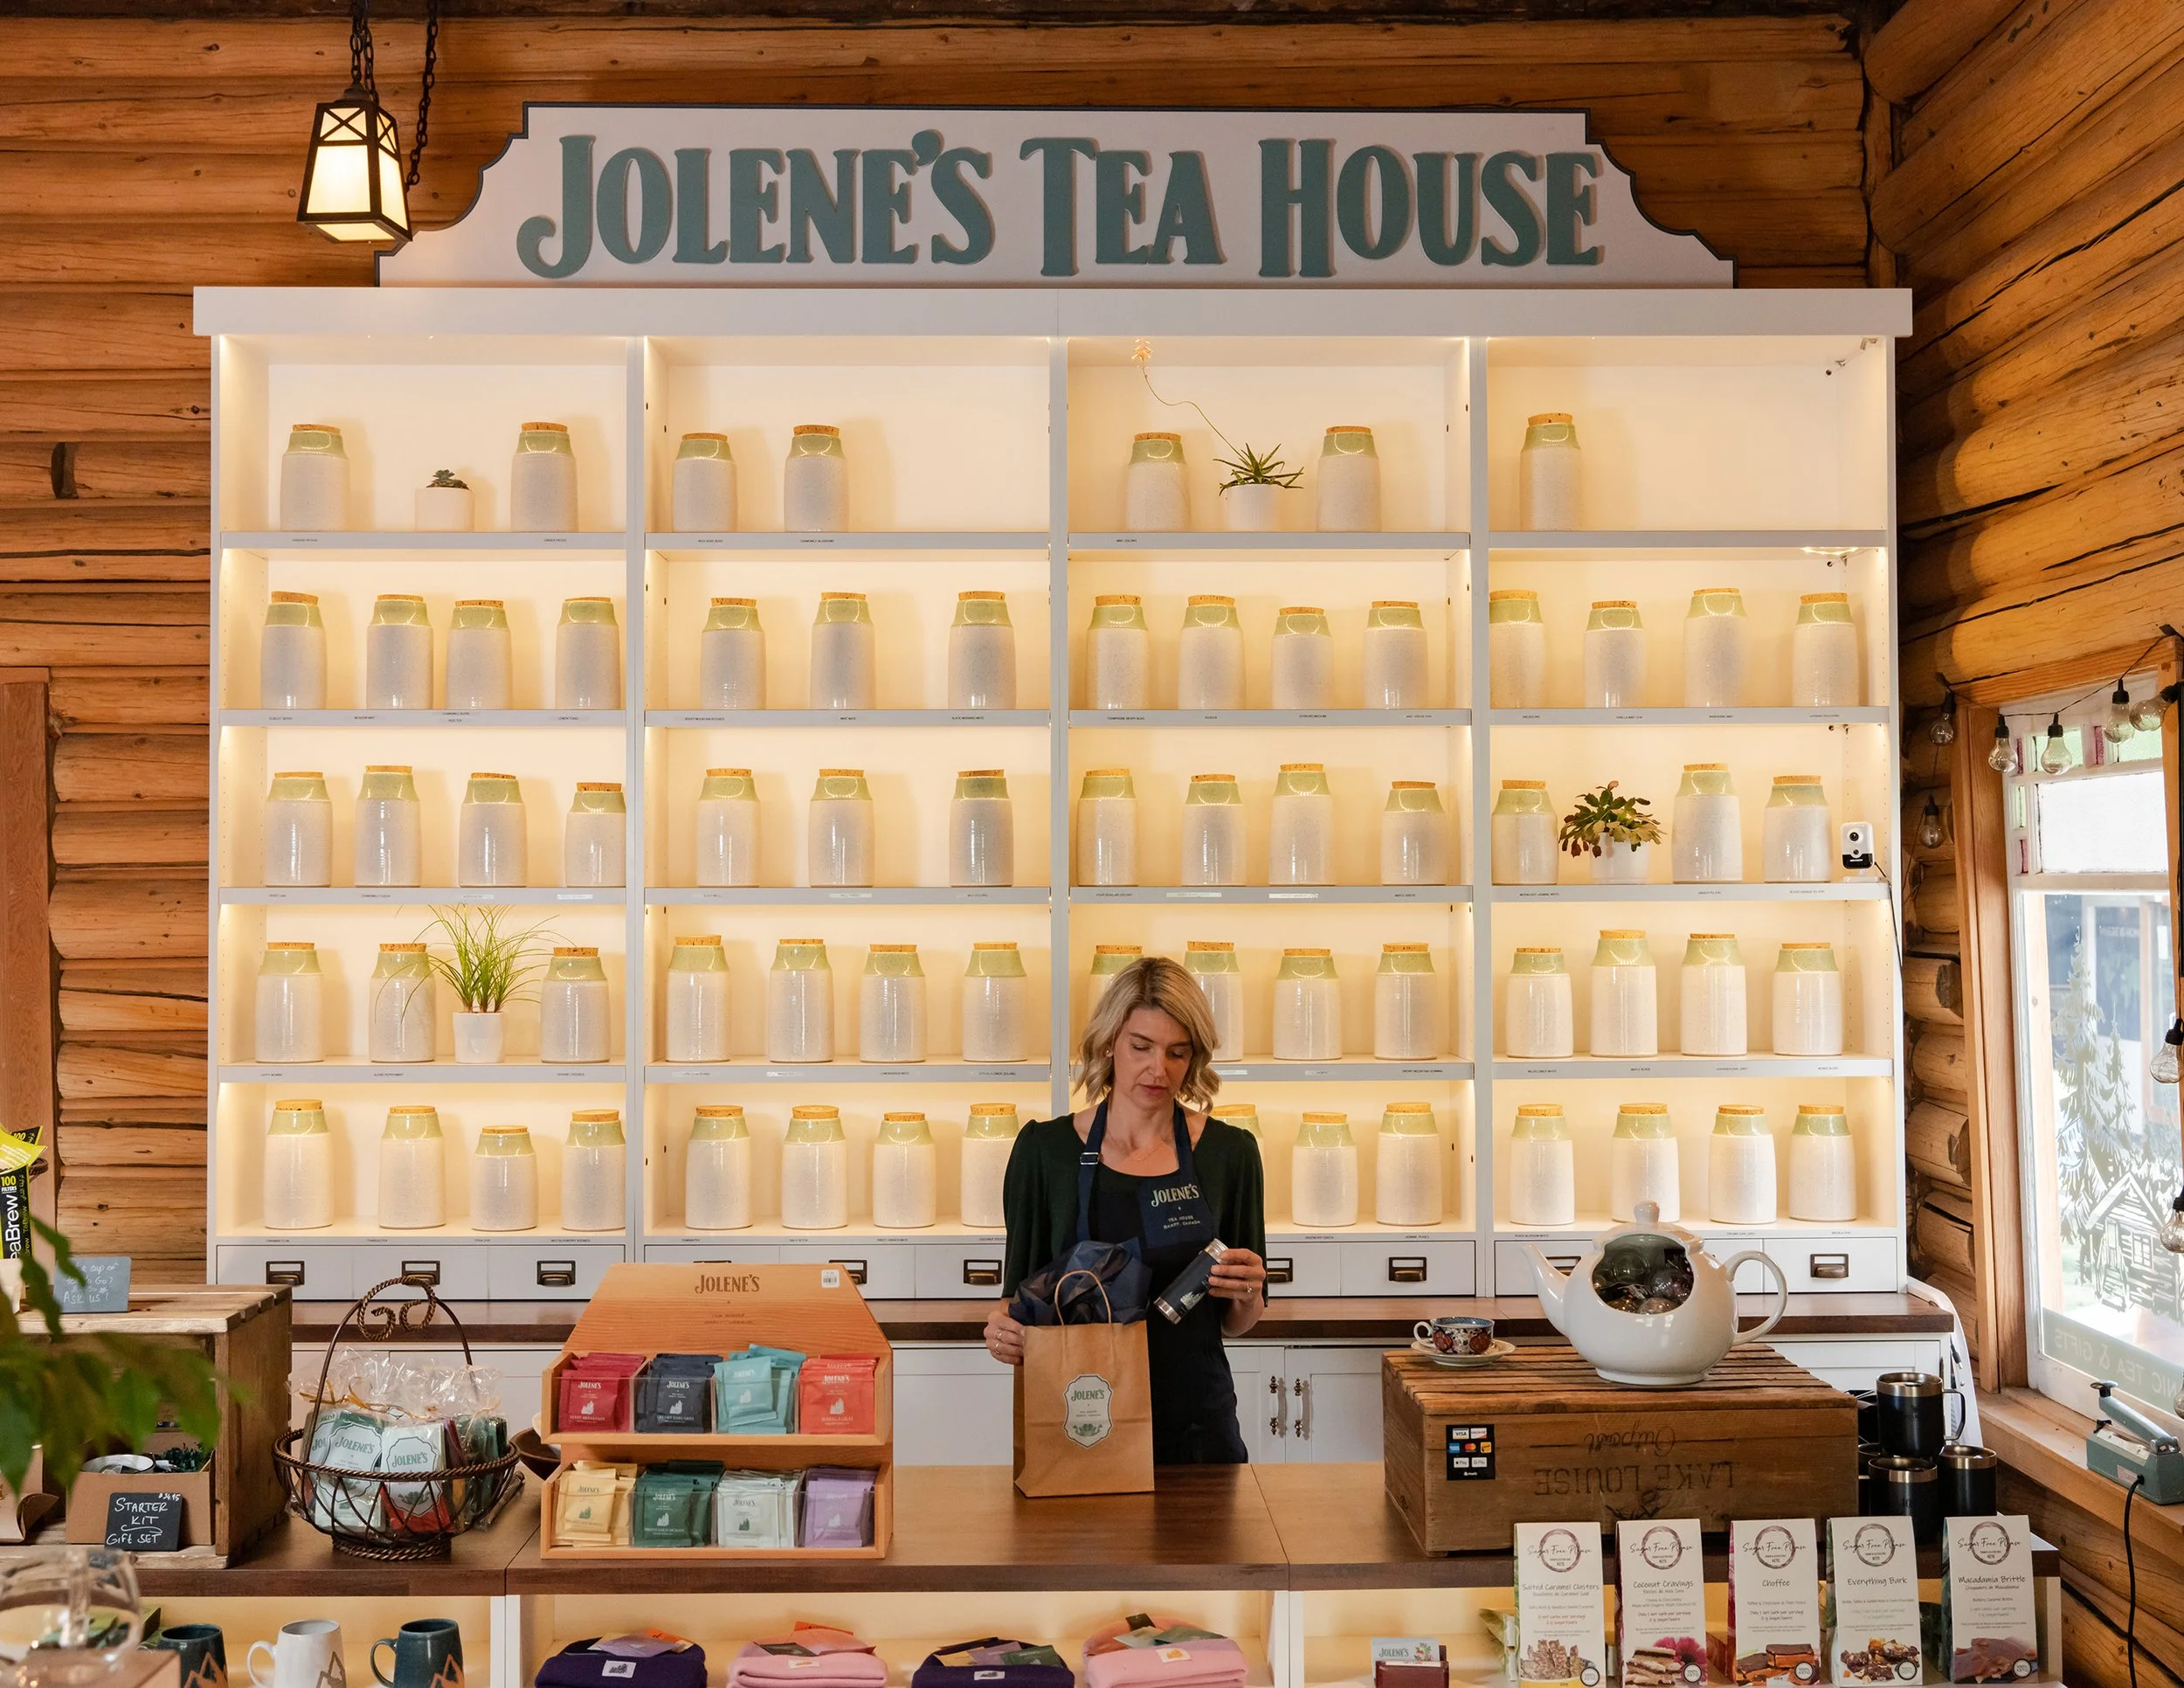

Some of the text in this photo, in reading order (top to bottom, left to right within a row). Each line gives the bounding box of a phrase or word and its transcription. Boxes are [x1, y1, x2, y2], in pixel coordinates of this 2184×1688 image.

[516, 129, 1604, 279] JOLENE'S TEA HOUSE
[1, 1175, 17, 1186] 100
[1151, 1183, 1199, 1207] JOLENE'S
[5, 1194, 23, 1259] eaBrew
[695, 1274, 760, 1294] JOLENE'S
[1070, 1389, 1105, 1401] JOLENE'S
[335, 1435, 376, 1455] JOLENE'S
[391, 1450, 428, 1468] JOLENE'S
[1532, 1462, 1739, 1496] LAKE LOUISE
[114, 1497, 169, 1513] STARTER
[131, 1514, 159, 1525] KIT
[137, 1533, 162, 1544] SET
[1762, 1579, 1790, 1588] Choffee
[1847, 1576, 1908, 1588] Everything Bark
[2001, 1574, 2026, 1583] Brittle
[1573, 1582, 1600, 1591] Clusters
[1662, 1580, 1694, 1590] Cravings
[1379, 1648, 1409, 1658] JOLENE'S
